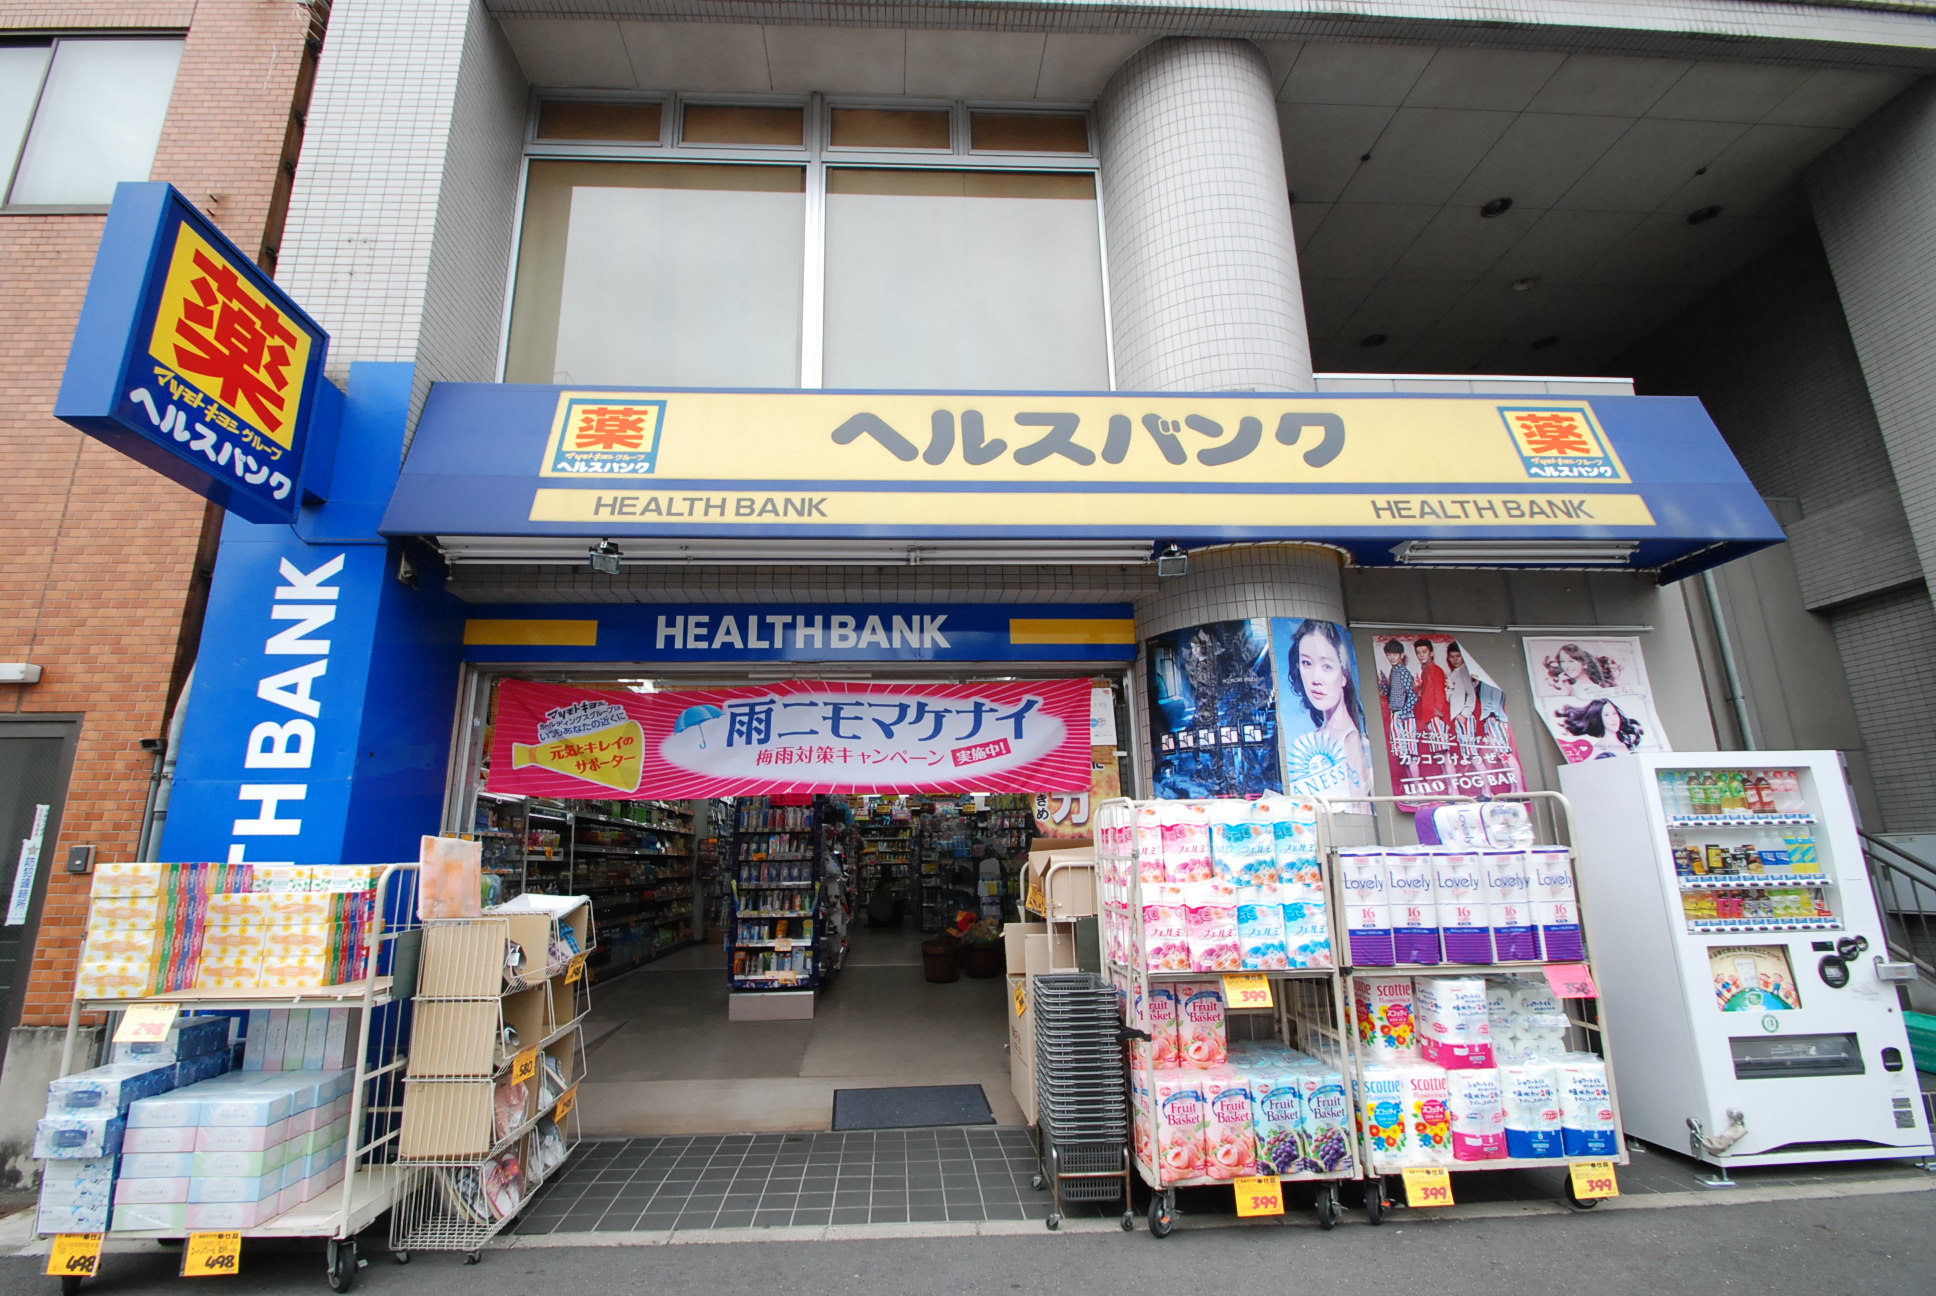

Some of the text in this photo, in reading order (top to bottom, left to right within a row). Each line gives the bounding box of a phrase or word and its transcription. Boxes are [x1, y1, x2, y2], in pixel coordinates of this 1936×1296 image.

[172, 248, 298, 433] 薬
[575, 407, 648, 450] 薬
[1515, 413, 1590, 455] 薬
[129, 387, 292, 500] ヘルスバンク
[831, 409, 1345, 468] ヘルスバンク
[556, 461, 650, 473] ヘルスバンク
[1529, 466, 1613, 477] ヘルスバンク
[593, 496, 829, 518] HEALTH BANK
[1370, 500, 1597, 519] HEALTH BANK
[546, 700, 606, 719] マツモトキヨシ
[540, 712, 626, 741] いつもあなたの近くに
[726, 698, 1039, 747] 雨ニモマケナイ
[549, 736, 634, 761] 元気とキレイの
[955, 742, 1007, 764] 実施中!
[756, 746, 945, 767] 梅雨対策キャンペーン
[1399, 753, 1497, 766] カッコつけようぜ
[575, 754, 636, 774] サポーター
[1403, 772, 1518, 795] uno FOG BAR
[1343, 871, 1384, 891] Lovely
[1389, 870, 1431, 892] Lovely
[1437, 870, 1480, 891] Lovely
[1536, 868, 1573, 888] Lovely
[1362, 907, 1376, 919] 16
[1407, 906, 1421, 918] 16
[1456, 906, 1471, 918] 16
[1504, 905, 1517, 917] 16
[1555, 903, 1567, 915] 16
[1377, 983, 1411, 996] scottie
[1563, 982, 1591, 995] 358
[1240, 990, 1268, 1003] 399
[1149, 1001, 1168, 1010] ruit
[1192, 1001, 1218, 1011] Fruit
[1190, 1012, 1221, 1022] Basket
[131, 1022, 166, 1036] 298
[1364, 1080, 1400, 1093] scottie
[1411, 1078, 1446, 1091] scottie
[1171, 1102, 1197, 1113] Fruit
[1220, 1100, 1245, 1111] Fruit
[1269, 1098, 1294, 1109] Fruit
[1316, 1096, 1341, 1107] Fruit
[1167, 1113, 1200, 1125] Basket
[1217, 1111, 1249, 1123] Basket
[1266, 1109, 1299, 1121] Basket
[1313, 1107, 1345, 1119] Basket
[1586, 1178, 1613, 1193] 399
[1420, 1186, 1447, 1200] 399
[1251, 1195, 1278, 1210] 399
[65, 1254, 97, 1272] 498
[204, 1254, 236, 1270] 498
